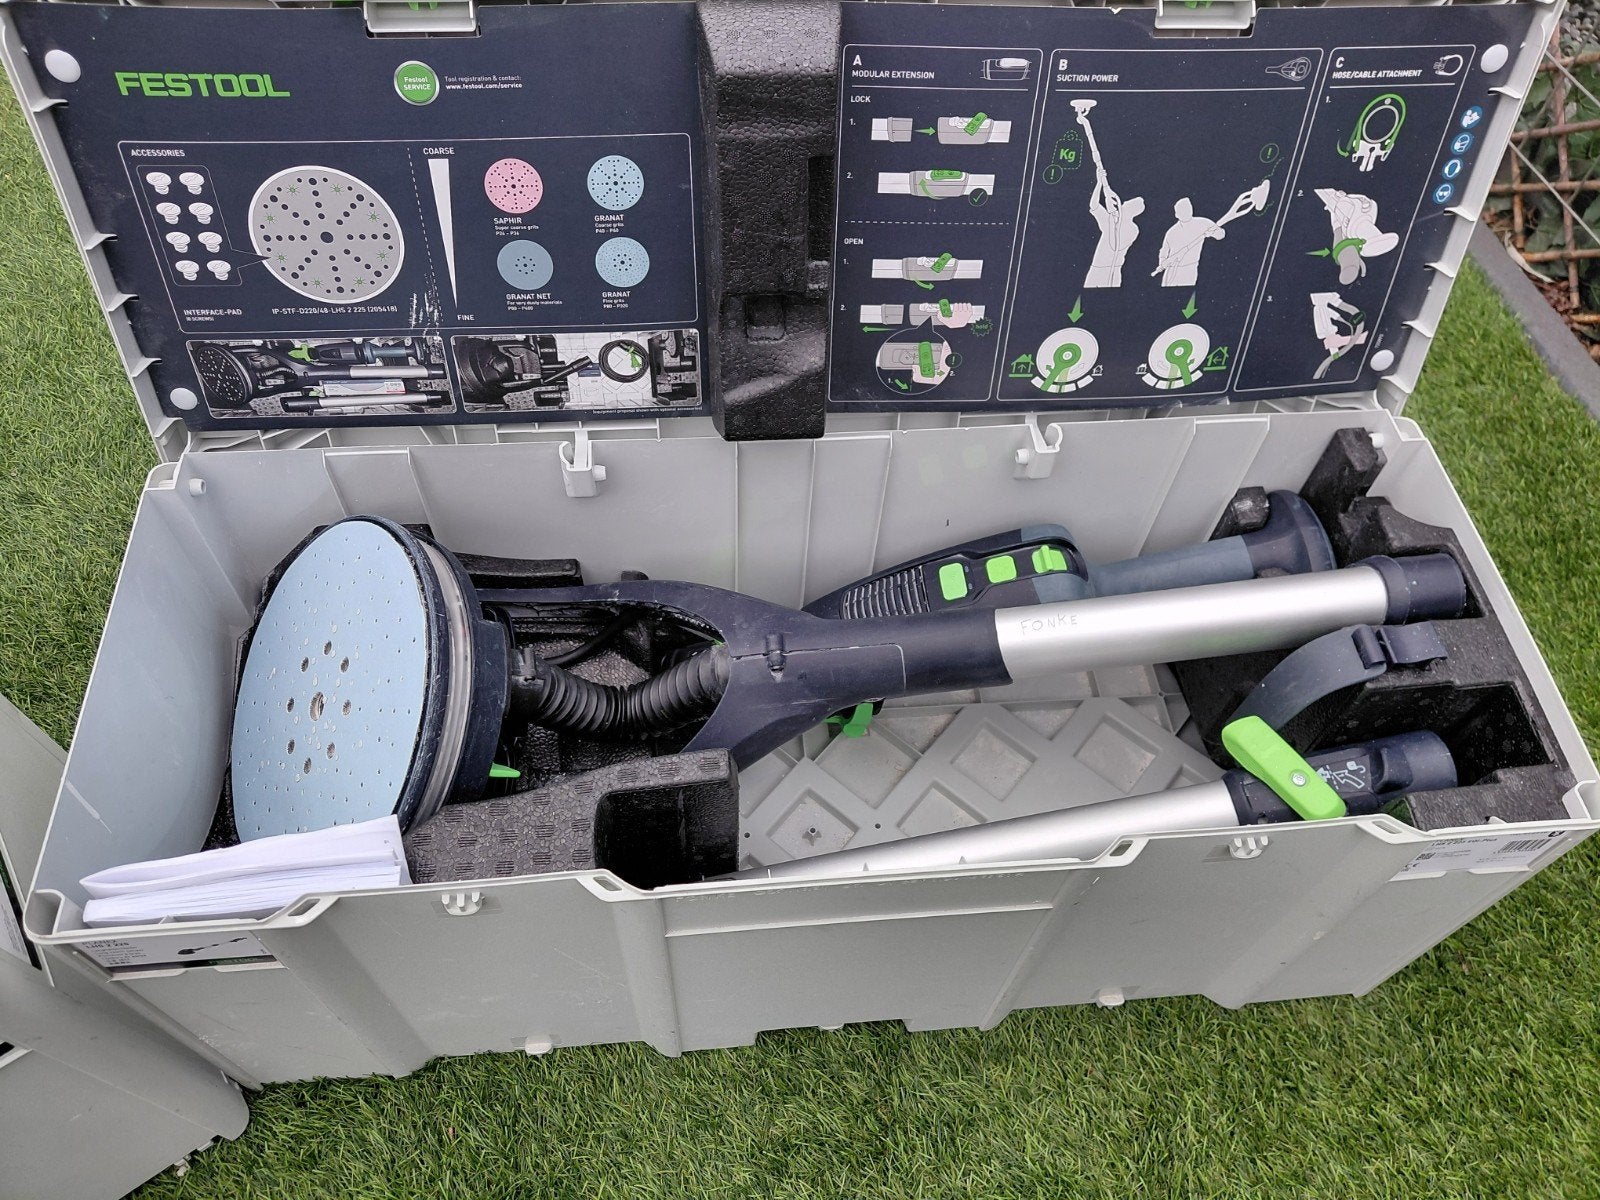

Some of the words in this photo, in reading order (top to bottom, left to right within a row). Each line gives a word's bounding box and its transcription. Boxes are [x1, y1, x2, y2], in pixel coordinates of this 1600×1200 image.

[852, 54, 863, 66] A
[1335, 56, 1345, 68] C
[1058, 59, 1068, 71] B
[851, 70, 890, 78] MODULAR
[891, 71, 935, 79] EXTENSION
[1056, 74, 1090, 82] SUCTION
[1090, 74, 1119, 82] POWER
[1332, 70, 1376, 79] HOSE/CABLE
[1376, 69, 1423, 78] ATTACHMENT
[458, 75, 492, 83] registration
[115, 72, 291, 97] FESTOOL
[446, 82, 523, 90] www.festool.com/service
[850, 95, 871, 103] LOCK
[849, 118, 856, 126] 1.
[131, 149, 186, 157] ACCESSORIES
[423, 147, 455, 155] COARSE
[1059, 148, 1076, 162] Kg
[846, 171, 854, 179] 2.
[493, 217, 523, 225] SAPHIR
[594, 214, 625, 222] GRANAT
[536, 292, 552, 300] NET
[602, 290, 631, 298] GRANAT
[183, 308, 243, 316] INTERFACE-PAD
[1020, 612, 1078, 636] FONKE
